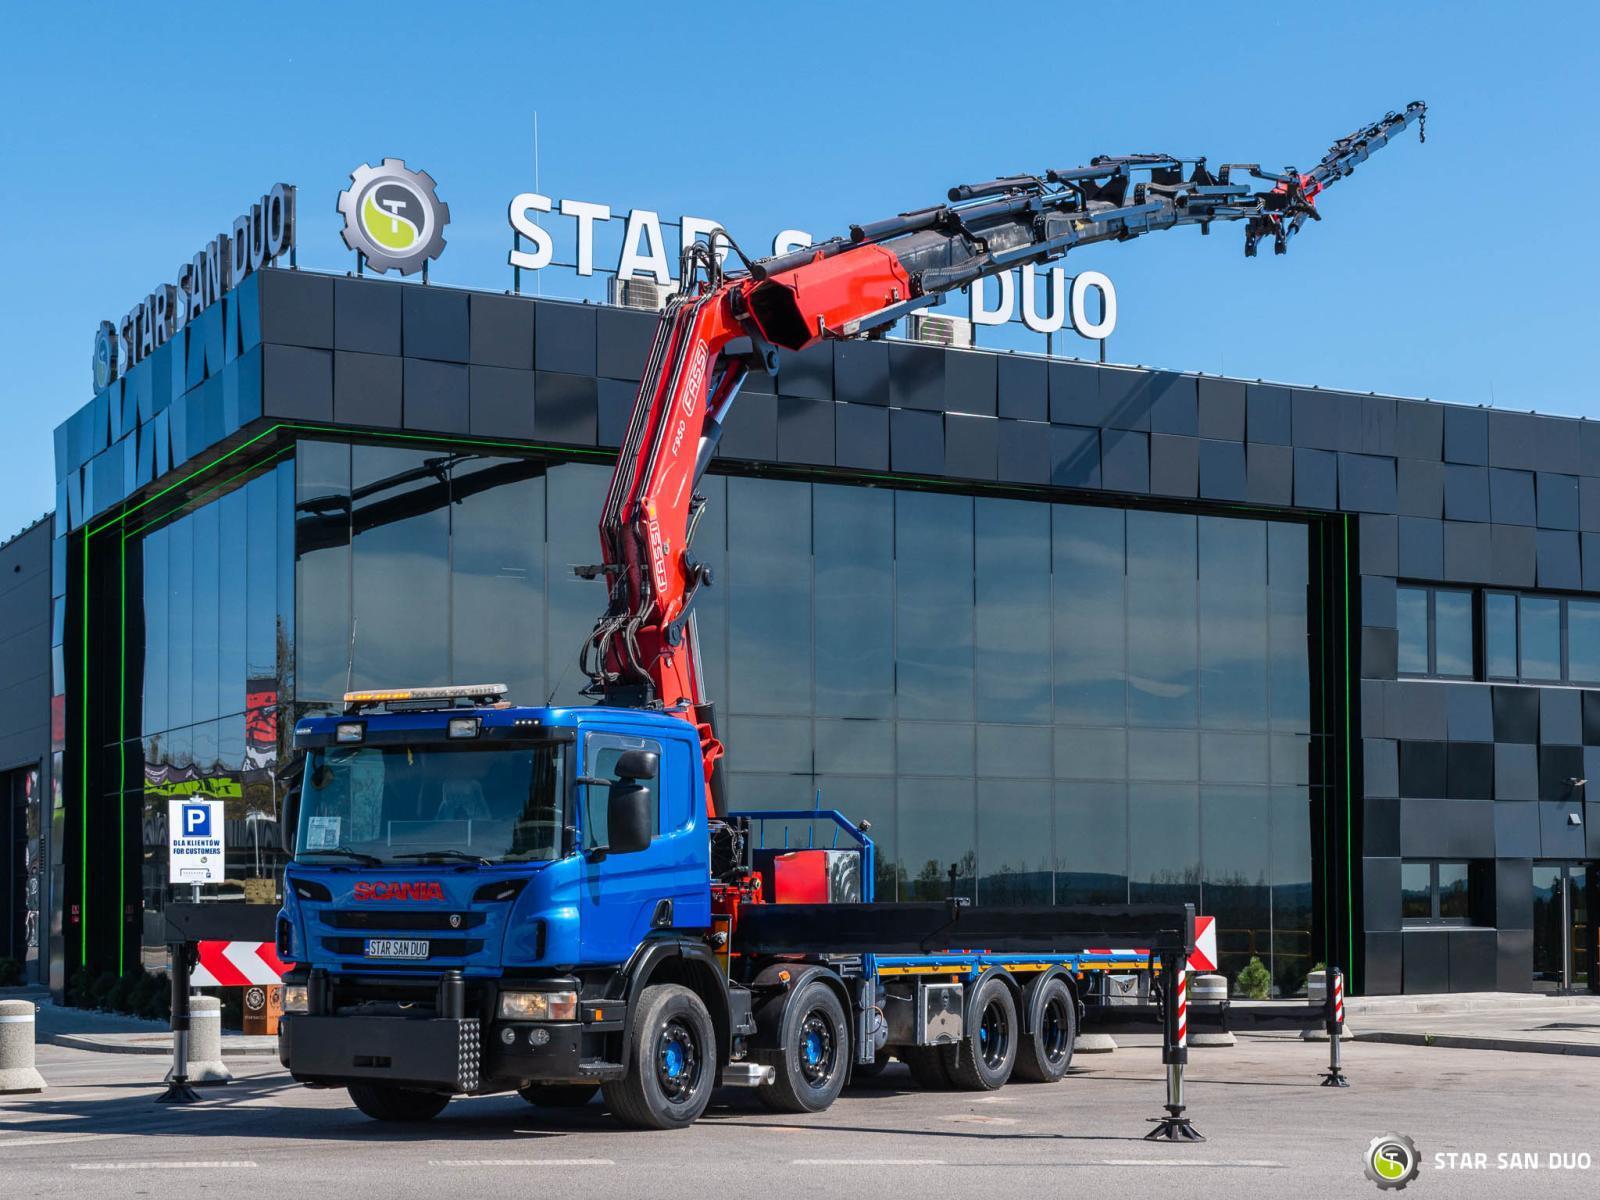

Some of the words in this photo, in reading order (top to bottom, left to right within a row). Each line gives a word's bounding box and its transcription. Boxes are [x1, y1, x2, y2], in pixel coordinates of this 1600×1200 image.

[118, 283, 169, 378] STAR
[176, 234, 223, 331] SAN
[232, 183, 287, 288] DUO
[970, 261, 1117, 340] DUO
[684, 346, 707, 411] FASSI
[650, 525, 667, 587] FASSI
[187, 809, 206, 833] P
[186, 847, 221, 855] CUSTOMERS
[187, 839, 220, 847] KLIENTÓW
[354, 880, 445, 901] SCANIA
[370, 941, 391, 955] STAR
[393, 941, 410, 955] SAN
[411, 942, 428, 956] DUO
